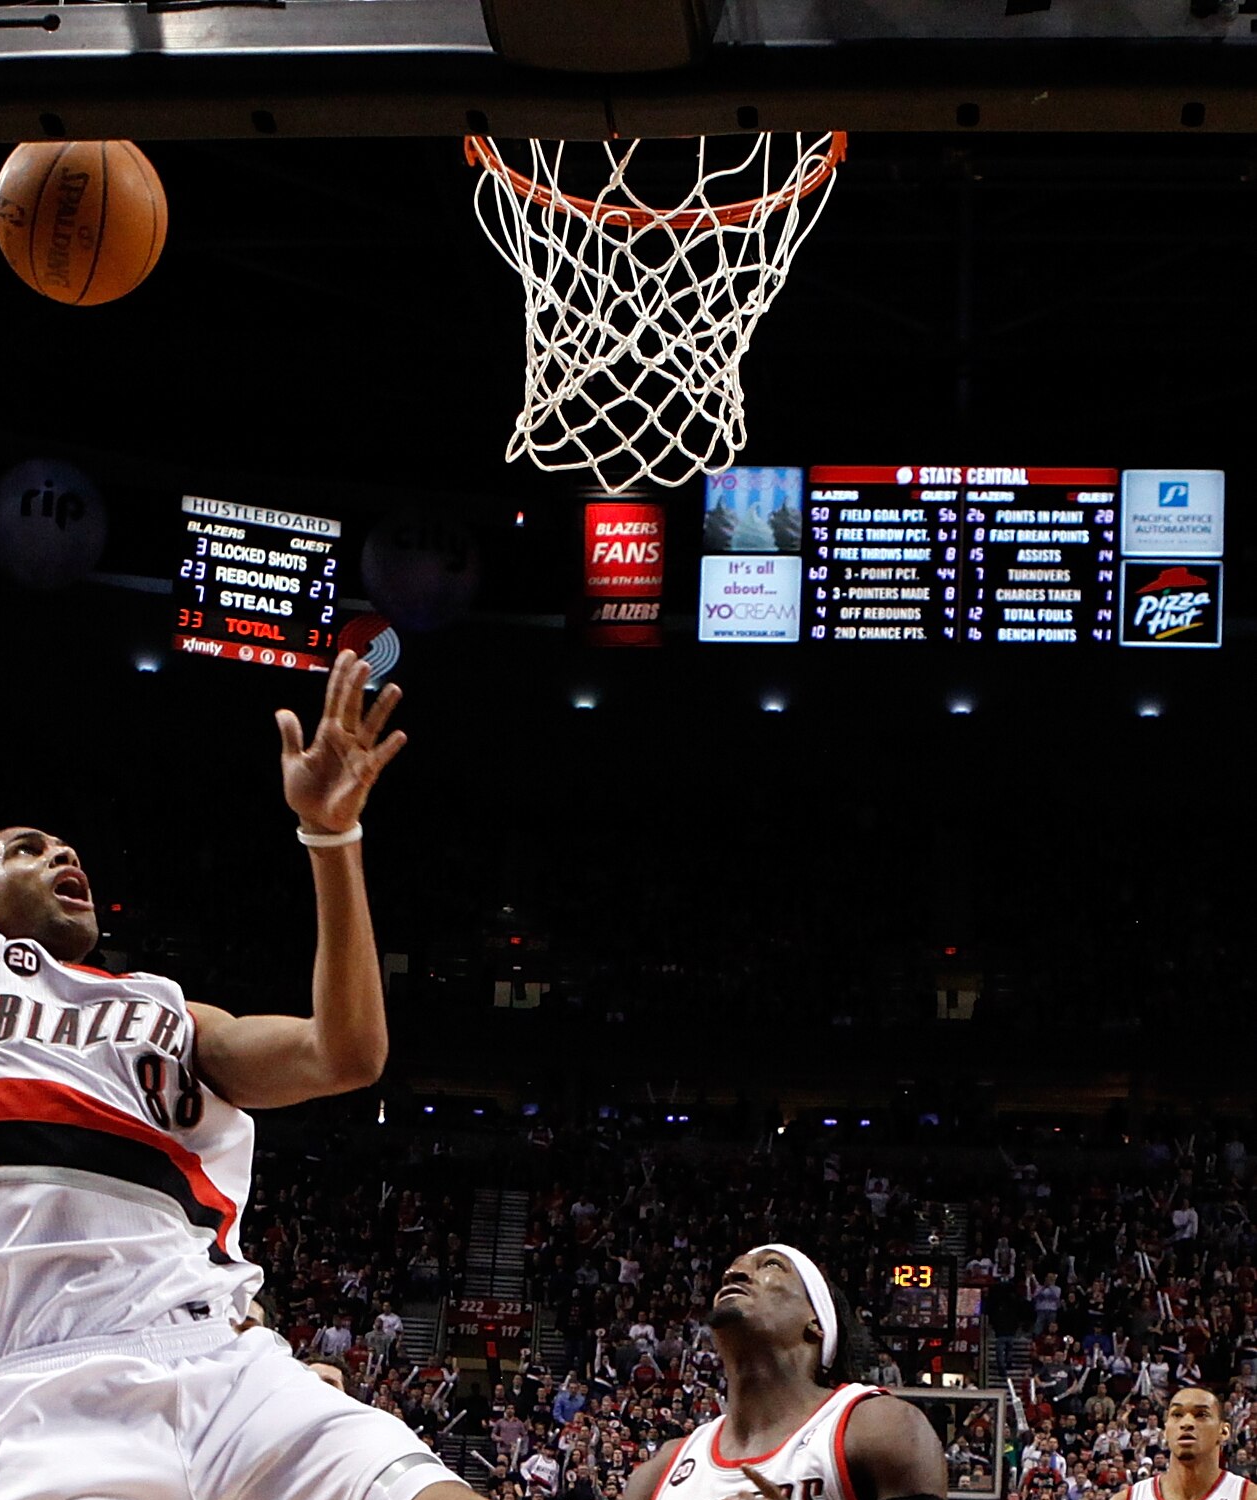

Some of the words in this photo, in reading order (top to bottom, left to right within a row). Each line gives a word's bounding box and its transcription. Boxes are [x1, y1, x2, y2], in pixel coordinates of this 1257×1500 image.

[919, 467, 962, 485] STATS
[966, 467, 1029, 486] CENTRAL
[811, 490, 859, 502] BLAZERS
[920, 490, 958, 502] GUEST
[966, 491, 1015, 502] BLAZERS
[1077, 492, 1115, 503] GUEST
[20, 480, 86, 532] rip
[193, 498, 330, 533] HUSTLEBOARD
[811, 507, 830, 521] 50
[840, 509, 872, 522] FIELD
[873, 509, 901, 522] GOAL
[902, 509, 928, 522] PCT.
[995, 509, 1036, 523] POINTS
[1036, 510, 1050, 523] IN
[1051, 510, 1084, 524] PAINT
[1132, 513, 1173, 523] PACIFIC
[1177, 513, 1212, 523] OFFICE
[595, 522, 659, 536] BLAZERS
[812, 527, 828, 542] 75
[835, 528, 864, 541] FREE
[865, 528, 904, 542] THROW
[905, 528, 931, 542] PCT.
[974, 528, 985, 542] 8
[989, 529, 1016, 543] FAST
[1016, 529, 1050, 543] BREAK
[1051, 530, 1090, 543] POINTS
[1102, 530, 1114, 543] 4
[1135, 525, 1212, 534] AUTOMATION
[187, 520, 246, 539] BLAZERS
[290, 538, 333, 554] GUEST
[196, 537, 207, 556] 3
[210, 542, 265, 564] BLOCKED
[268, 550, 307, 572] SHOTS
[323, 558, 336, 577] 2
[592, 542, 661, 564] FANS
[817, 546, 828, 559] 9
[833, 547, 859, 560] FREE
[861, 547, 902, 560] THROWS
[903, 548, 932, 561] MADE
[945, 547, 956, 561] 8
[1017, 549, 1062, 563] ASSISTS
[729, 561, 751, 575] It's
[756, 561, 774, 575] all
[895, 567, 920, 580] PCT.
[1007, 568, 1071, 582] TURNOVERS
[180, 559, 206, 580] 23
[215, 566, 300, 594] REBOUNDS
[309, 580, 335, 599] 27
[901, 587, 930, 600] MADE
[945, 587, 955, 600] 8
[995, 588, 1046, 602] CHARGES
[1047, 589, 1082, 602] TAKEN
[194, 585, 205, 603] 7
[220, 591, 293, 616] STEALS
[321, 605, 334, 624] 2
[601, 603, 660, 621] BLAZERS
[705, 603, 798, 620] YOCREAM
[1134, 589, 1211, 626] Pizza
[816, 606, 827, 618] 4
[840, 607, 862, 620] OFF
[863, 607, 922, 620] REBOUNDS
[944, 607, 955, 619] 4
[1003, 608, 1036, 622] TOTAL
[1037, 608, 1073, 622] FOULS
[178, 608, 203, 629] 33
[225, 617, 286, 641] TOTAL
[307, 629, 333, 648] 31
[1147, 608, 1202, 635] Hut
[811, 625, 826, 639] 10
[834, 627, 857, 640] 2ND
[858, 627, 902, 640] CHANCE
[903, 627, 928, 640] PTS.
[943, 627, 954, 639] 4
[997, 628, 1035, 642] BENCH
[1036, 628, 1077, 642] POINTS
[182, 637, 224, 656] xfinity
[8, 946, 37, 973] 20
[893, 1264, 934, 1288] 12.3
[460, 1300, 484, 1313] 222
[497, 1302, 521, 1315] 223
[458, 1323, 479, 1336] 116
[501, 1325, 522, 1338] 117
